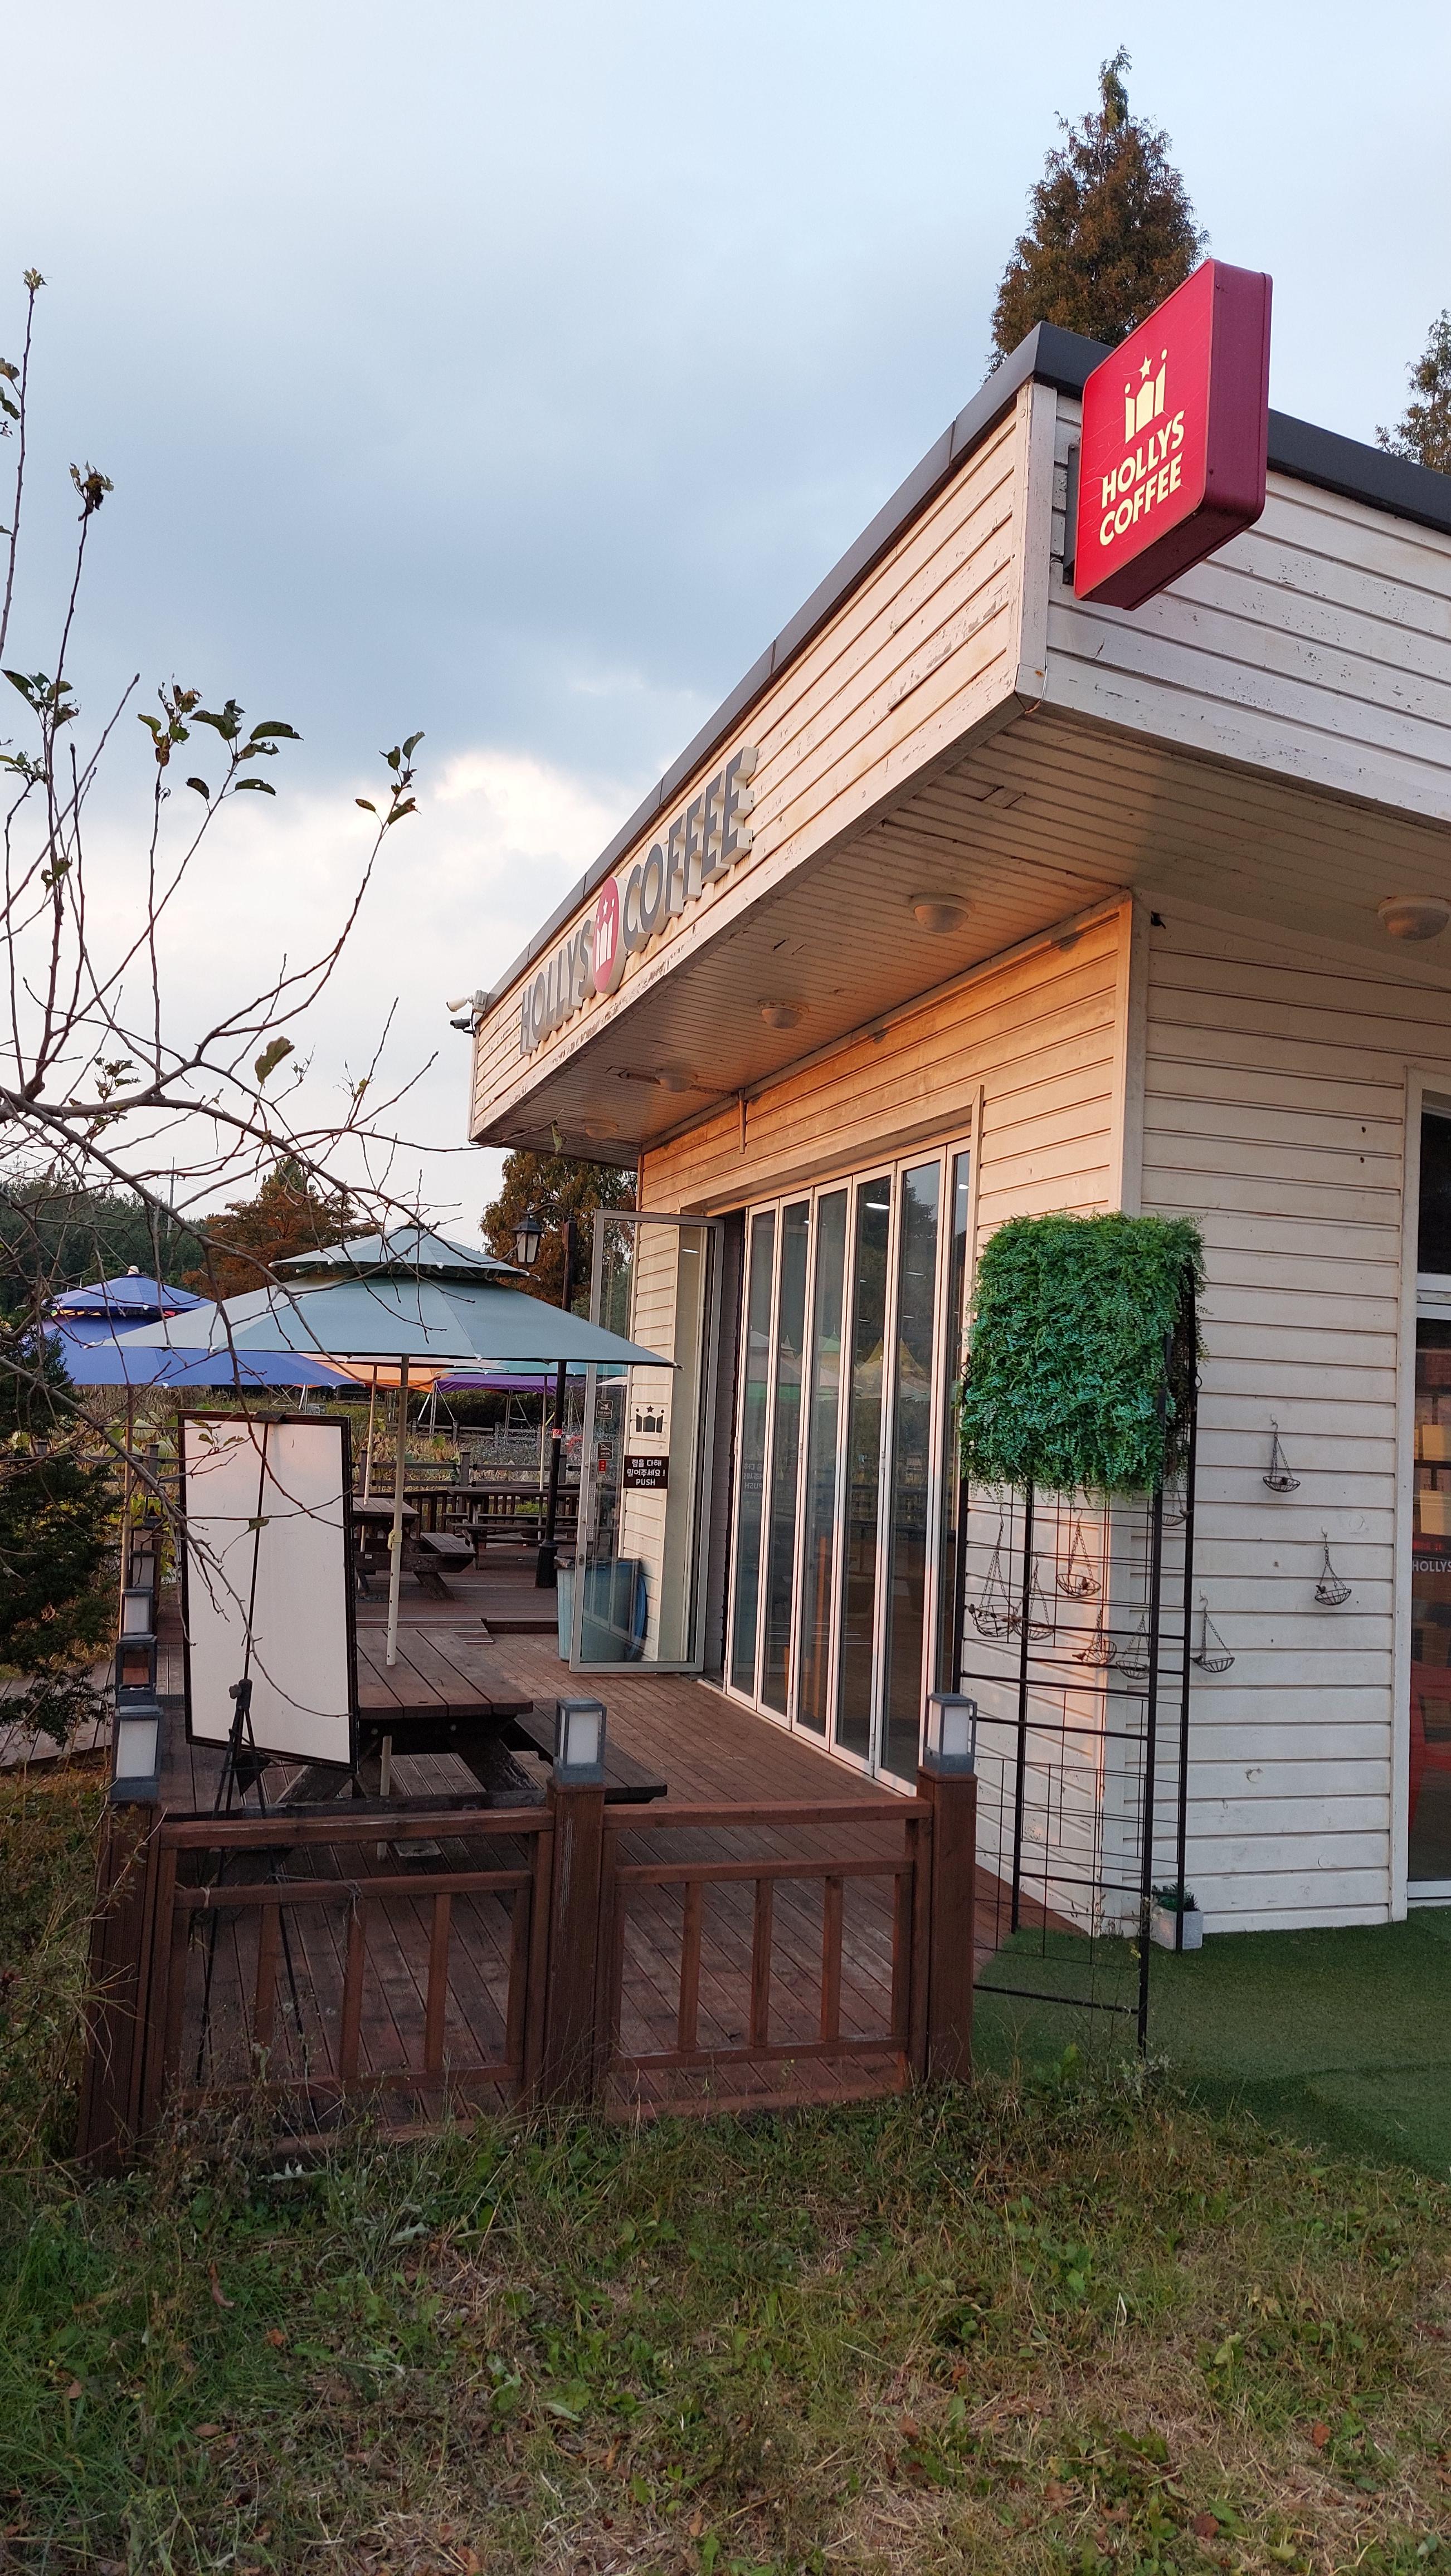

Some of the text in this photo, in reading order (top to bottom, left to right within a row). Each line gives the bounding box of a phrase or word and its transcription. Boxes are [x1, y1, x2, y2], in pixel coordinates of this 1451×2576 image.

[1099, 452, 1182, 546] COFFEE
[1101, 409, 1185, 509] HOLLYS
[520, 747, 757, 1055] HOLLYS COFFEE
[631, 1458, 662, 1467] 힘을 다해
[1412, 1560, 1451, 1573] HOLLYS
